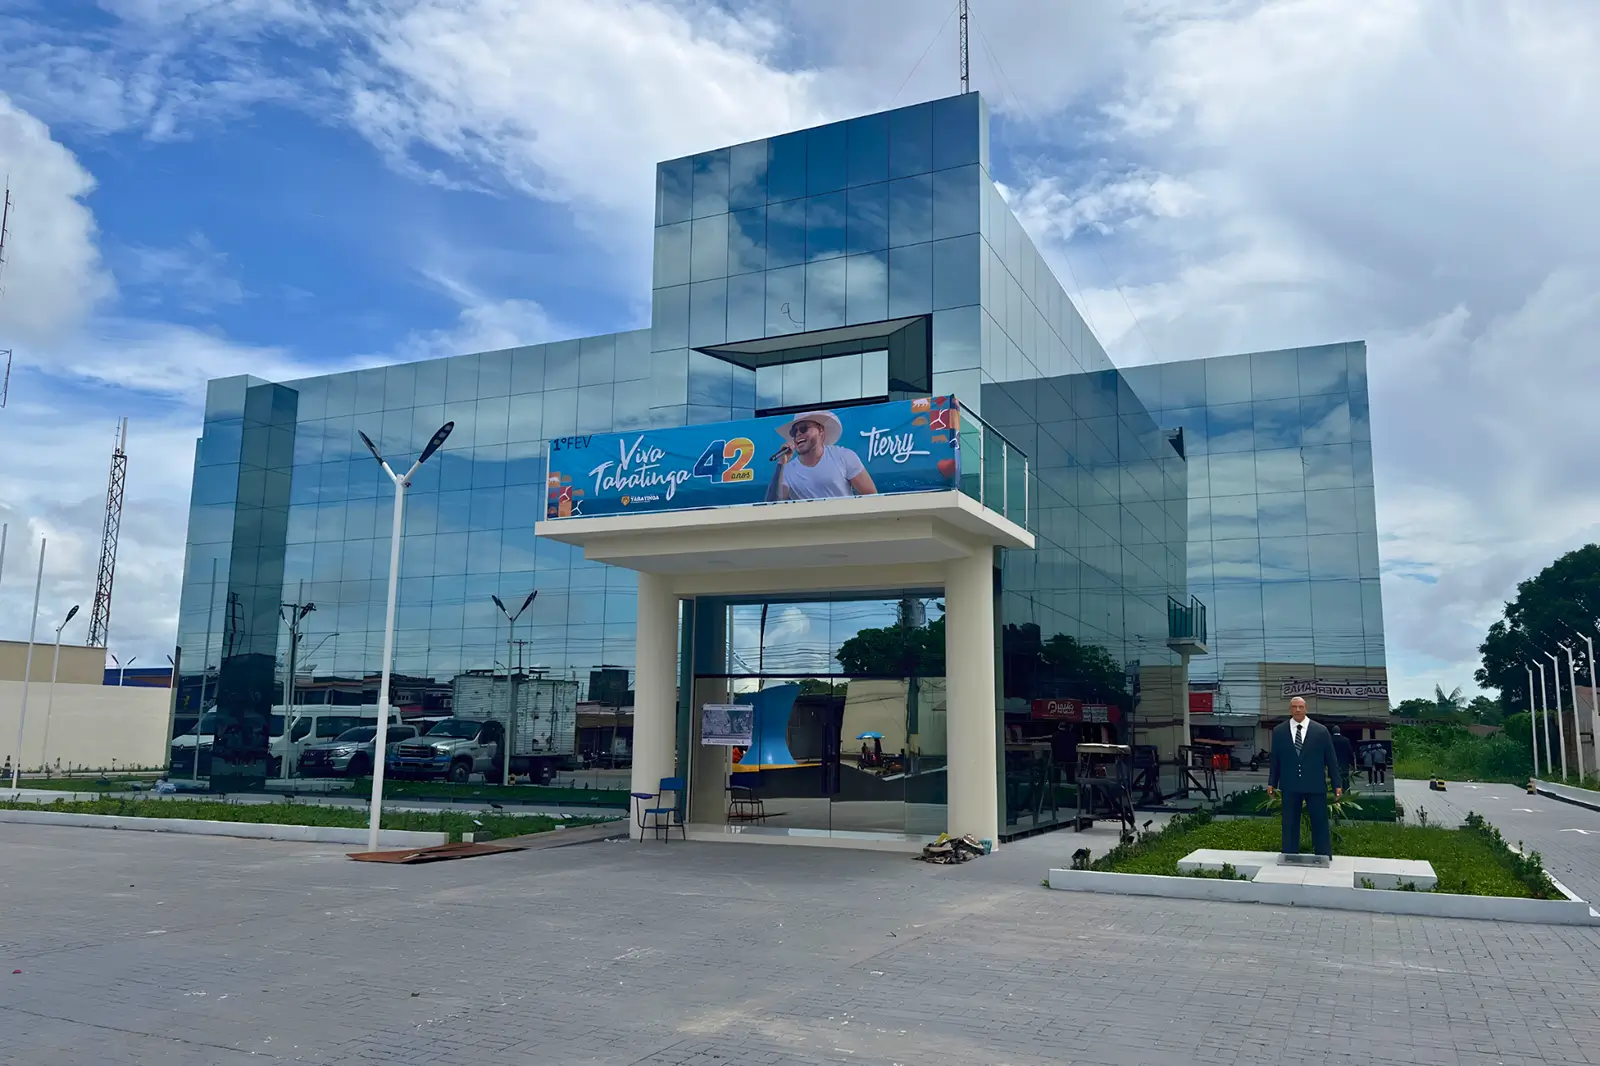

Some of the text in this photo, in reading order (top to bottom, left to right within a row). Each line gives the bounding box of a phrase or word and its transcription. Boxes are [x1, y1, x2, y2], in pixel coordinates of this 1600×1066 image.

[620, 435, 665, 470] Viva
[693, 437, 755, 484] 42
[860, 426, 930, 464] Tierry
[588, 460, 691, 501] Tabatinga
[731, 471, 751, 480] anos
